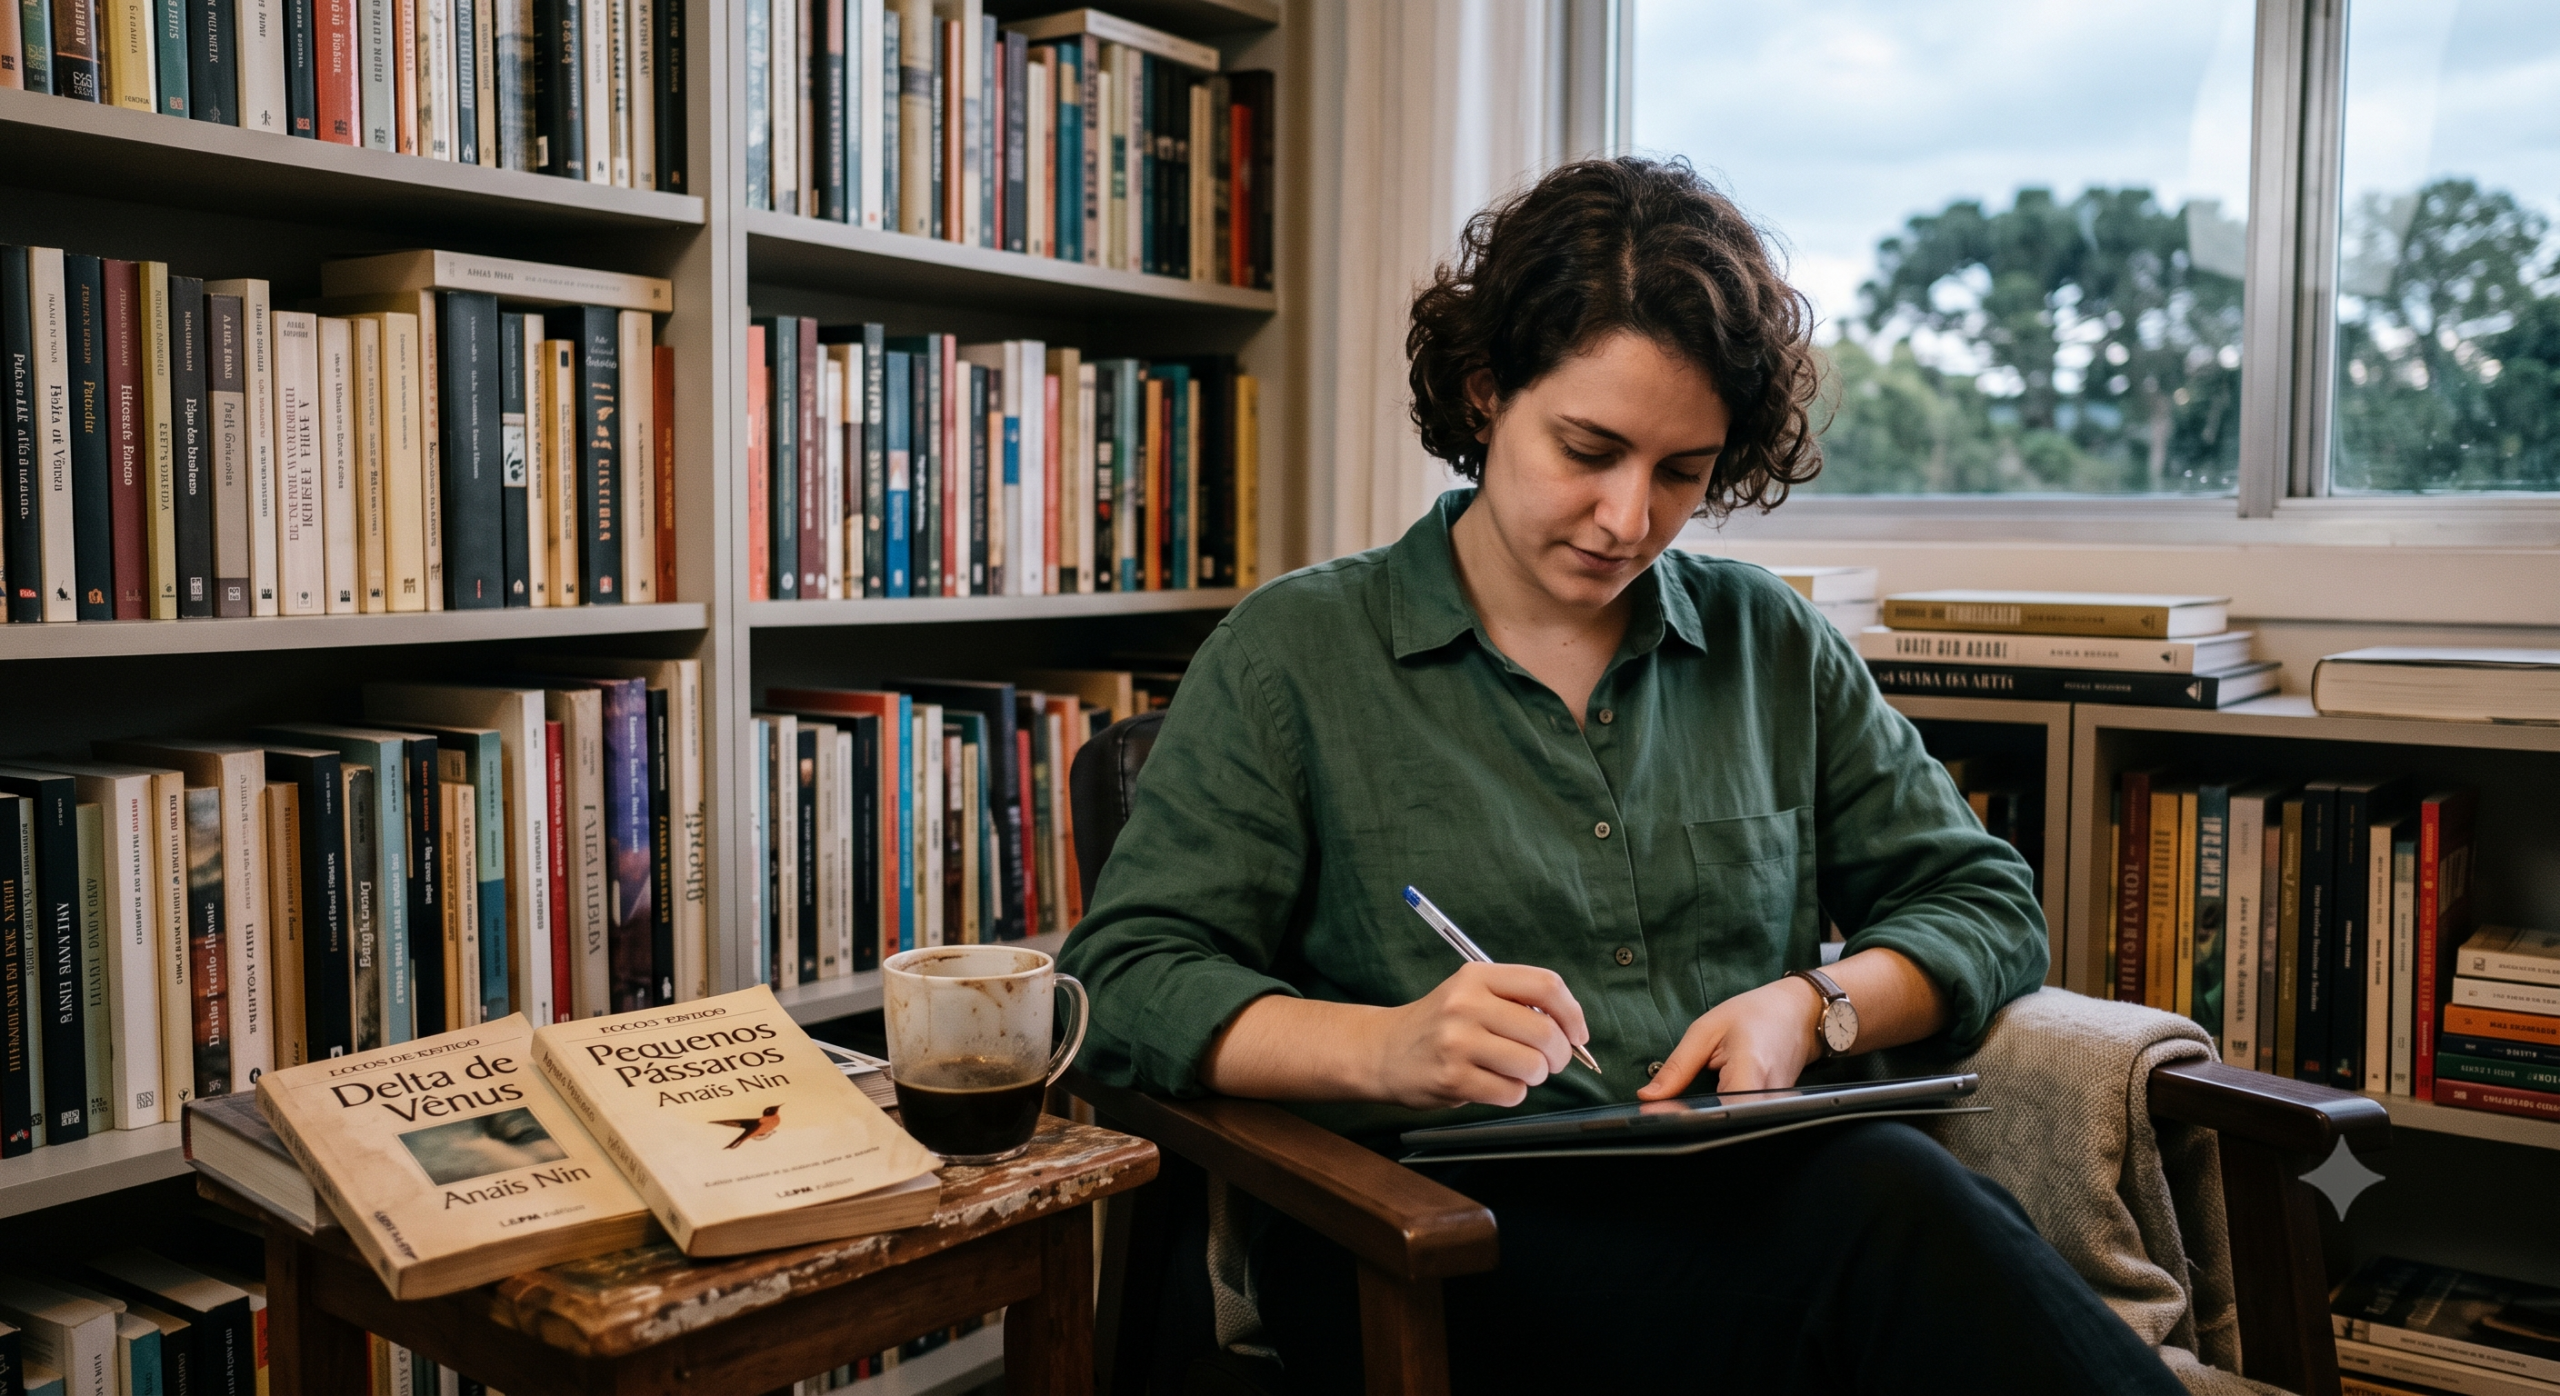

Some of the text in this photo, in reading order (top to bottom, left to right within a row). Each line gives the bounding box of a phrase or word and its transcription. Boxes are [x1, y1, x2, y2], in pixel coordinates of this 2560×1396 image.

[585, 1023, 777, 1067] Pequenos
[331, 1054, 519, 1109] Delta de
[614, 1047, 785, 1088] Pássaros
[382, 1083, 524, 1122] Vênus
[658, 1072, 791, 1108] Anaïs Nin
[443, 1165, 592, 1210] Anaïs Nin
